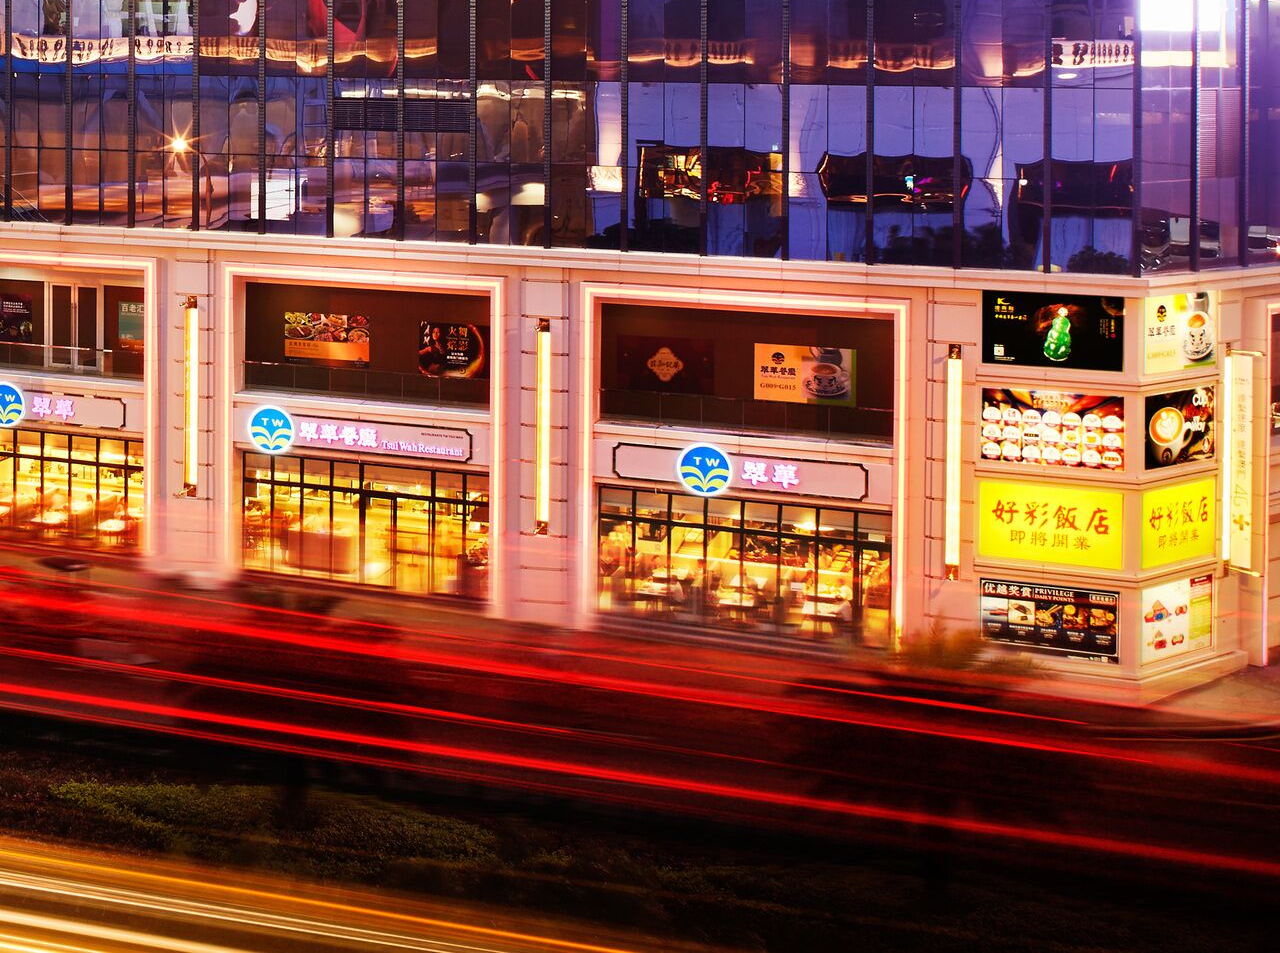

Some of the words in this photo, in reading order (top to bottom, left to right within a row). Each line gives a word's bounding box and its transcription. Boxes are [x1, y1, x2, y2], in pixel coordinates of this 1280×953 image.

[381, 440, 399, 451] Tsui
[399, 441, 418, 453] Wah
[418, 443, 463, 456] Restaurant
[692, 456, 720, 467] TW
[991, 499, 1110, 535] 好彩飯店
[1009, 529, 1092, 551] 即將開業
[1034, 587, 1075, 598] PRIVILEGE
[1034, 593, 1053, 601] DAILY
[1053, 595, 1076, 603] POINTS
